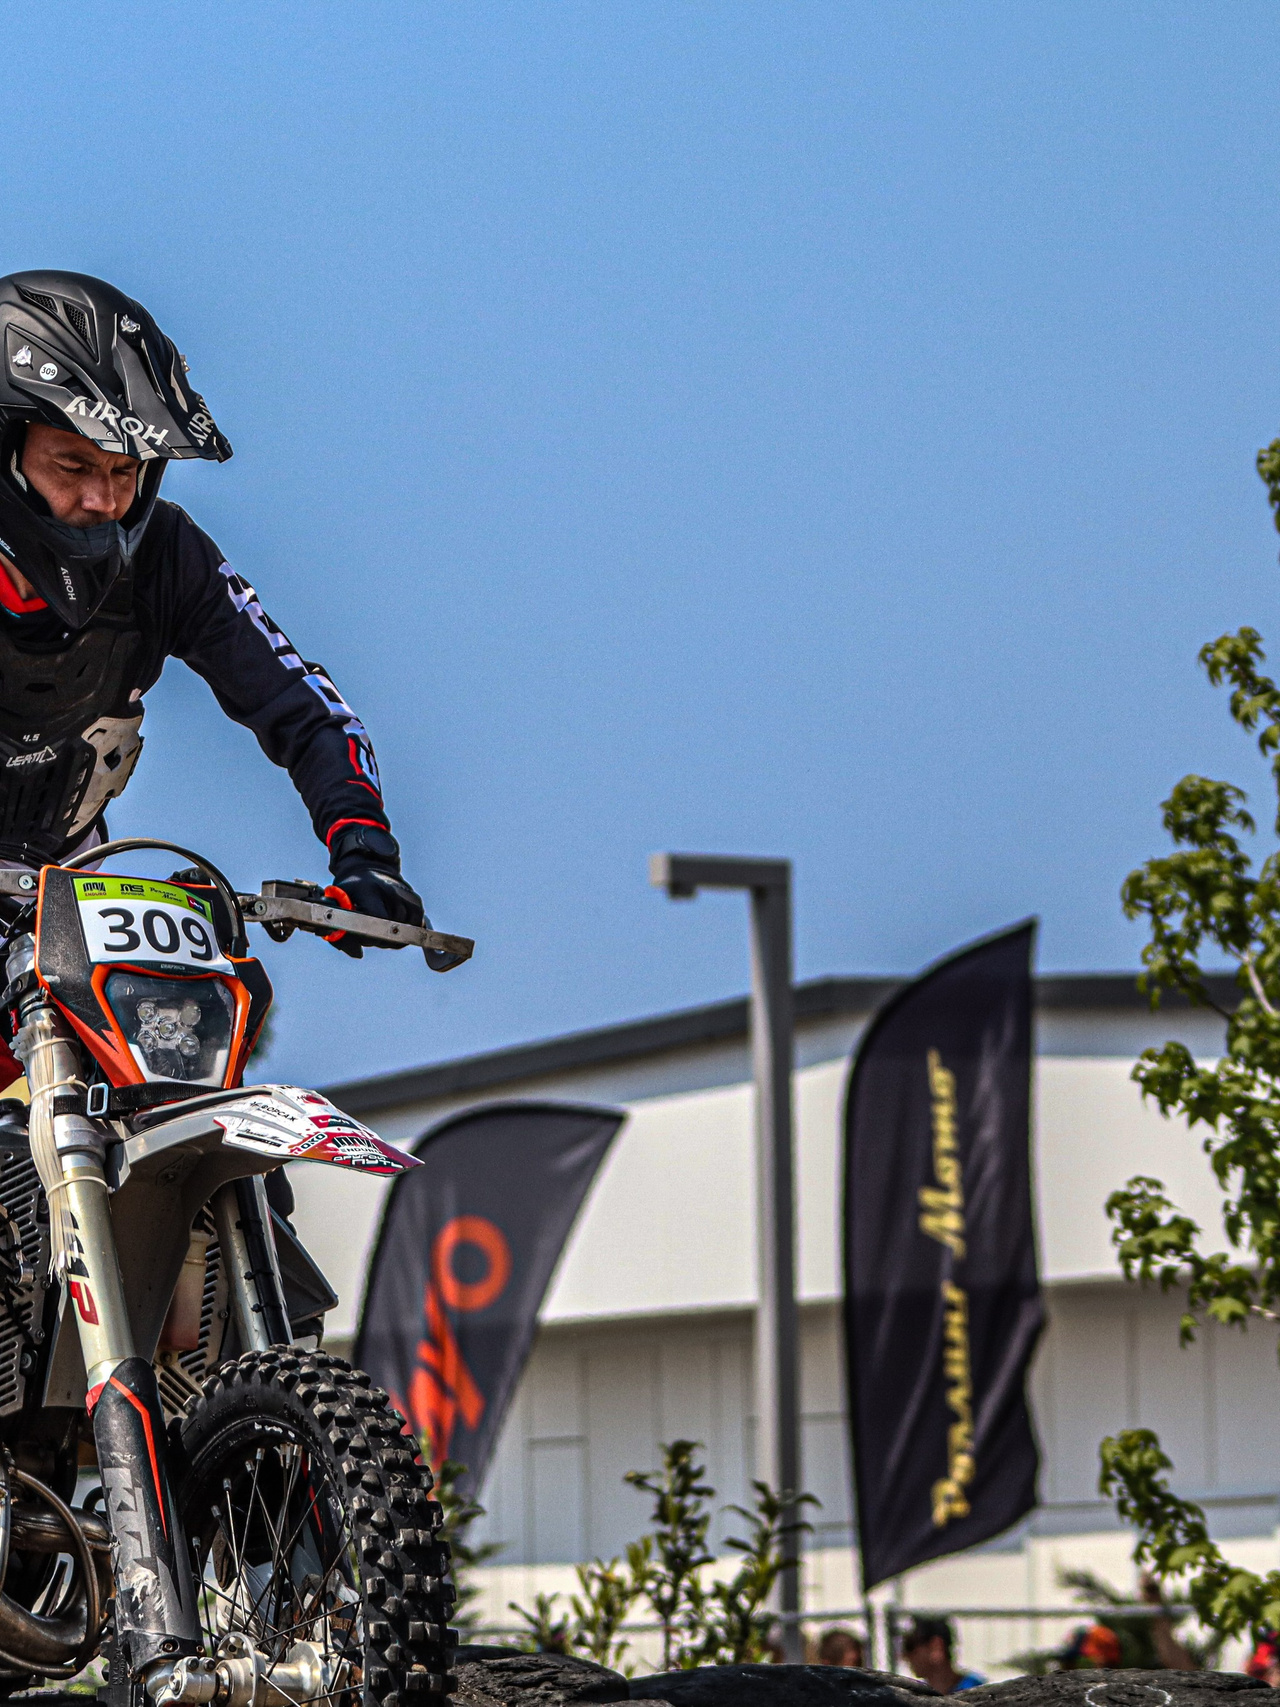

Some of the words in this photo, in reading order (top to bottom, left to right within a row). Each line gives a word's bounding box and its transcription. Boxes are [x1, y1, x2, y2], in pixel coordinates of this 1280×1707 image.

[41, 366, 56, 376] 309
[64, 395, 169, 446] AIROH
[60, 566, 76, 600] AIROH
[23, 733, 40, 742] 4.5
[97, 906, 213, 962] 309
